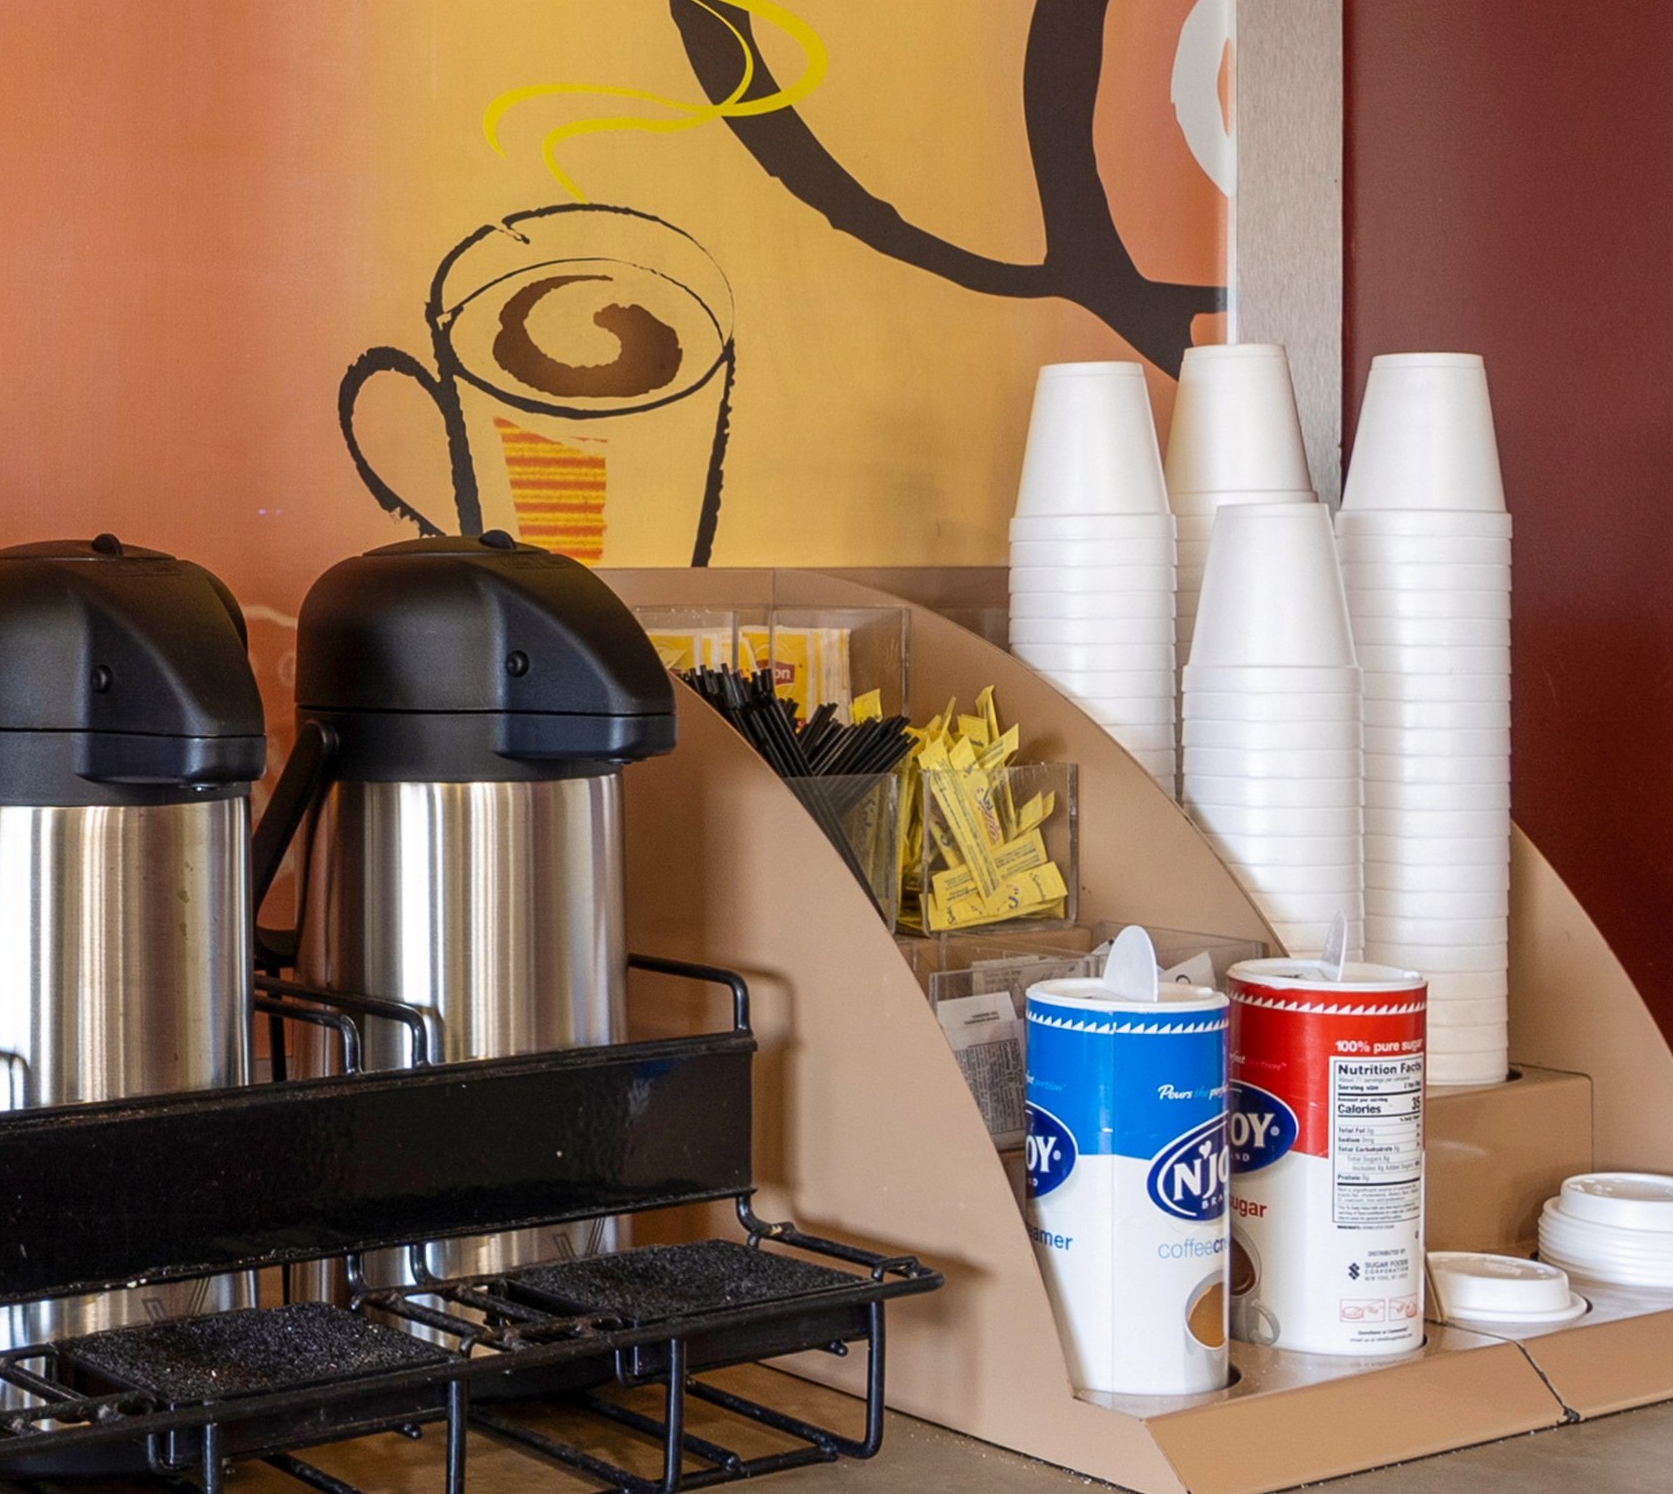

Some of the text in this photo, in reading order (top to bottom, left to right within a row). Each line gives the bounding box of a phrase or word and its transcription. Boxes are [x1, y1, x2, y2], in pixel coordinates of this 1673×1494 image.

[1334, 1039, 1371, 1053] 100%
[1373, 1041, 1400, 1054] pure
[1338, 1062, 1421, 1075] Nutrition Facts
[1157, 1084, 1193, 1100] Pours
[1338, 1103, 1381, 1114] Calories
[1230, 1112, 1275, 1148] OY
